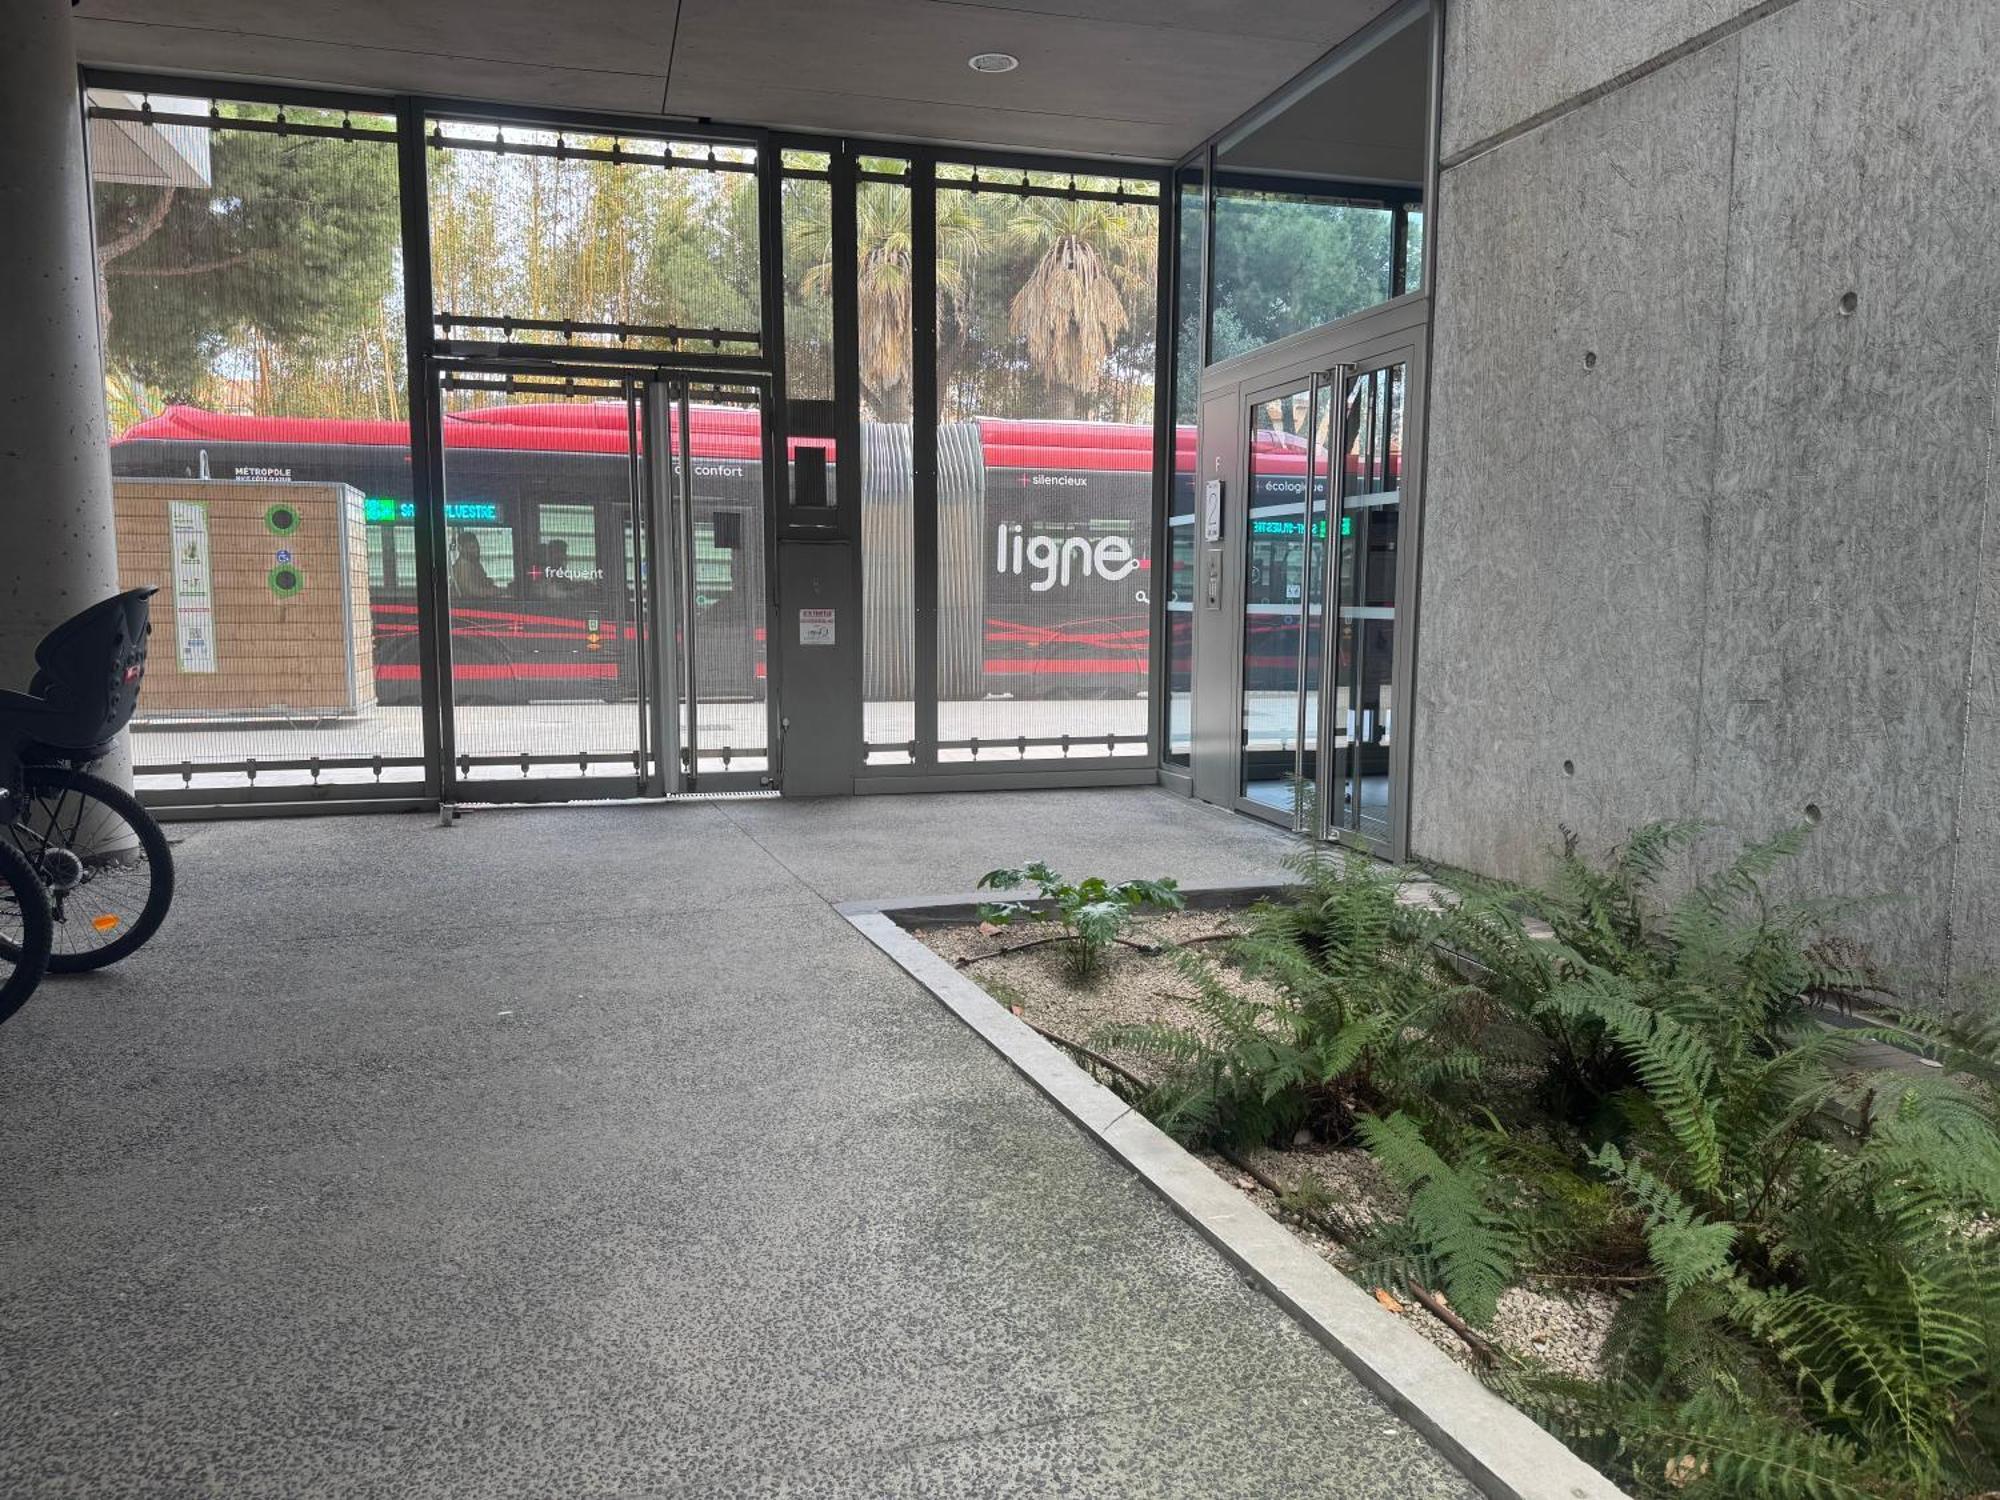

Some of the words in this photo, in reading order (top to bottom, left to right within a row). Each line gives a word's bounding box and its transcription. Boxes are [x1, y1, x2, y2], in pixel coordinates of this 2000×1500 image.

[694, 464, 744, 477] confort
[1032, 474, 1088, 487] silencieux
[1265, 481, 1324, 494] écologiue
[997, 523, 1141, 592] ligne
[545, 565, 605, 582] fréquent
